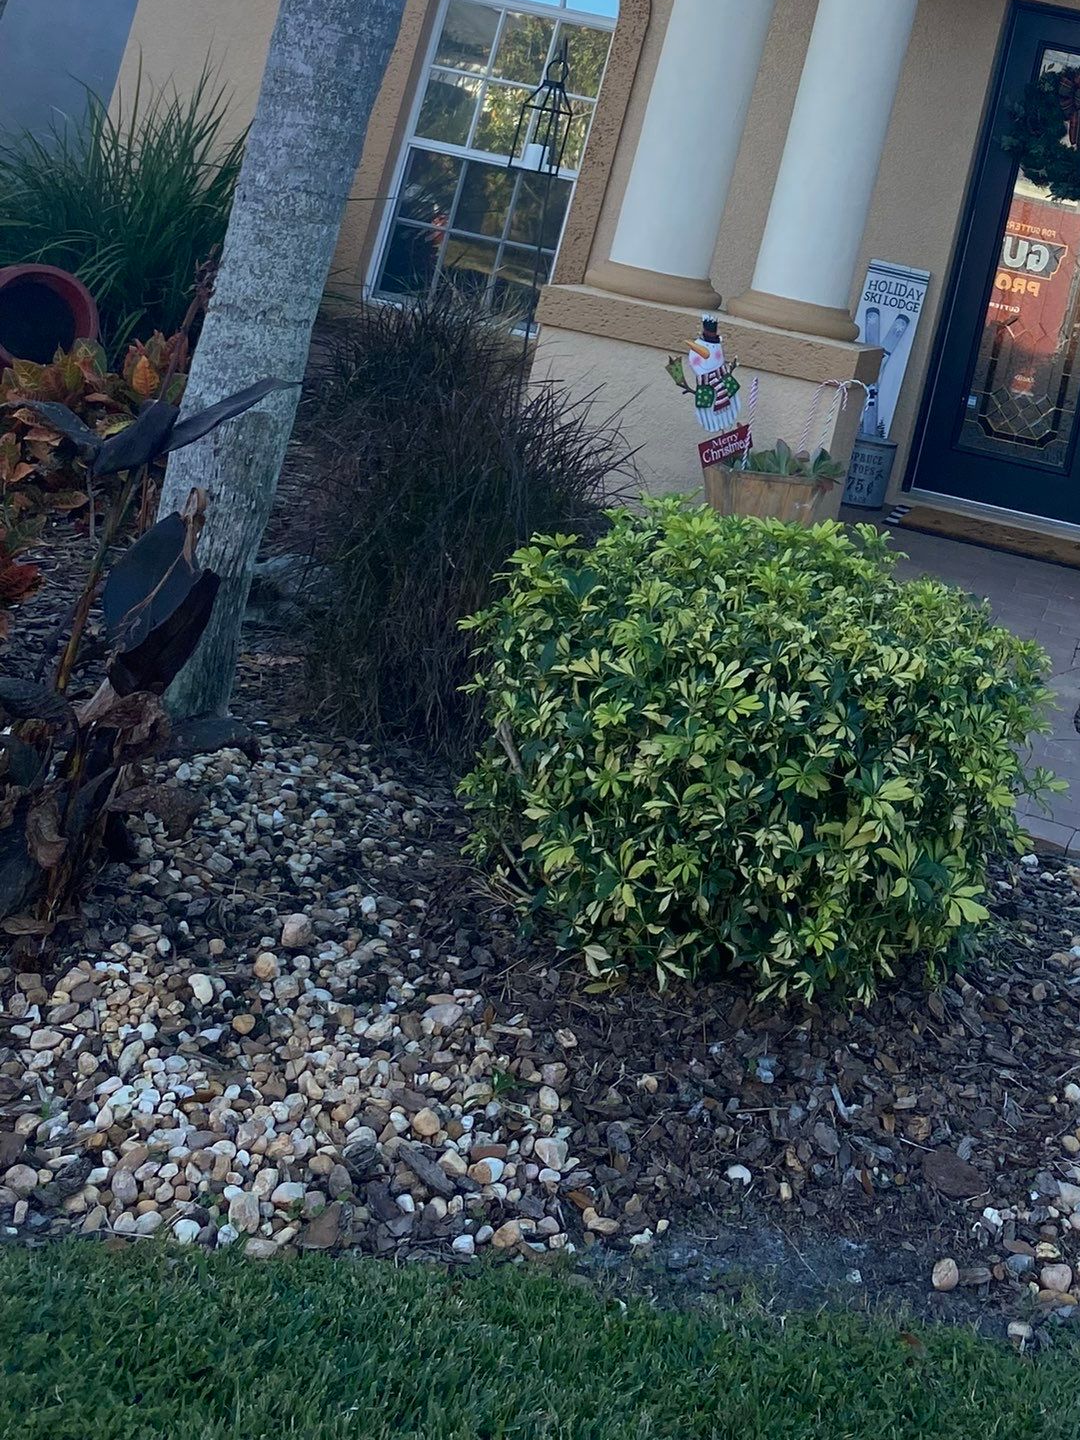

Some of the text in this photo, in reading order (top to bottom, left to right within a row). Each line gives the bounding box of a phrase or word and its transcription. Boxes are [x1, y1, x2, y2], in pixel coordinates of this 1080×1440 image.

[868, 280, 923, 301] HOLIDAY
[863, 291, 921, 313] SKI LODGE
[712, 433, 738, 447] Merry
